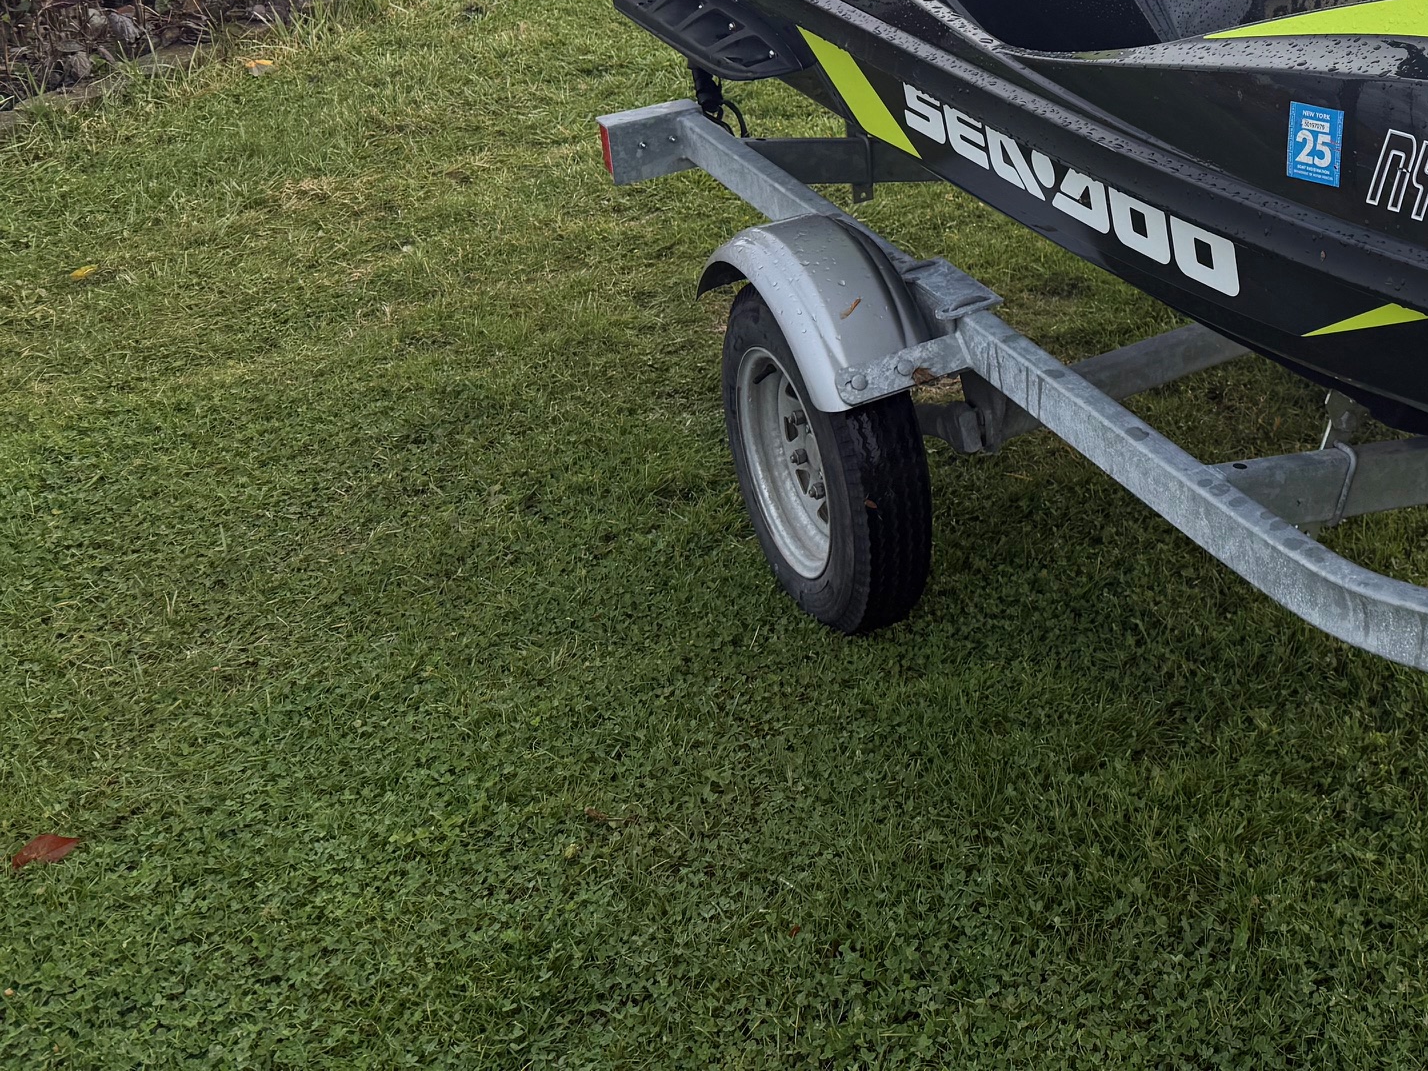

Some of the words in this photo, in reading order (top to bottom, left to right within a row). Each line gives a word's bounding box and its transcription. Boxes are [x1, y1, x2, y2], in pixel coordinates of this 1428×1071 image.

[1302, 110, 1315, 118] NEW
[1315, 112, 1331, 120] YORK
[1295, 129, 1332, 168] 25
